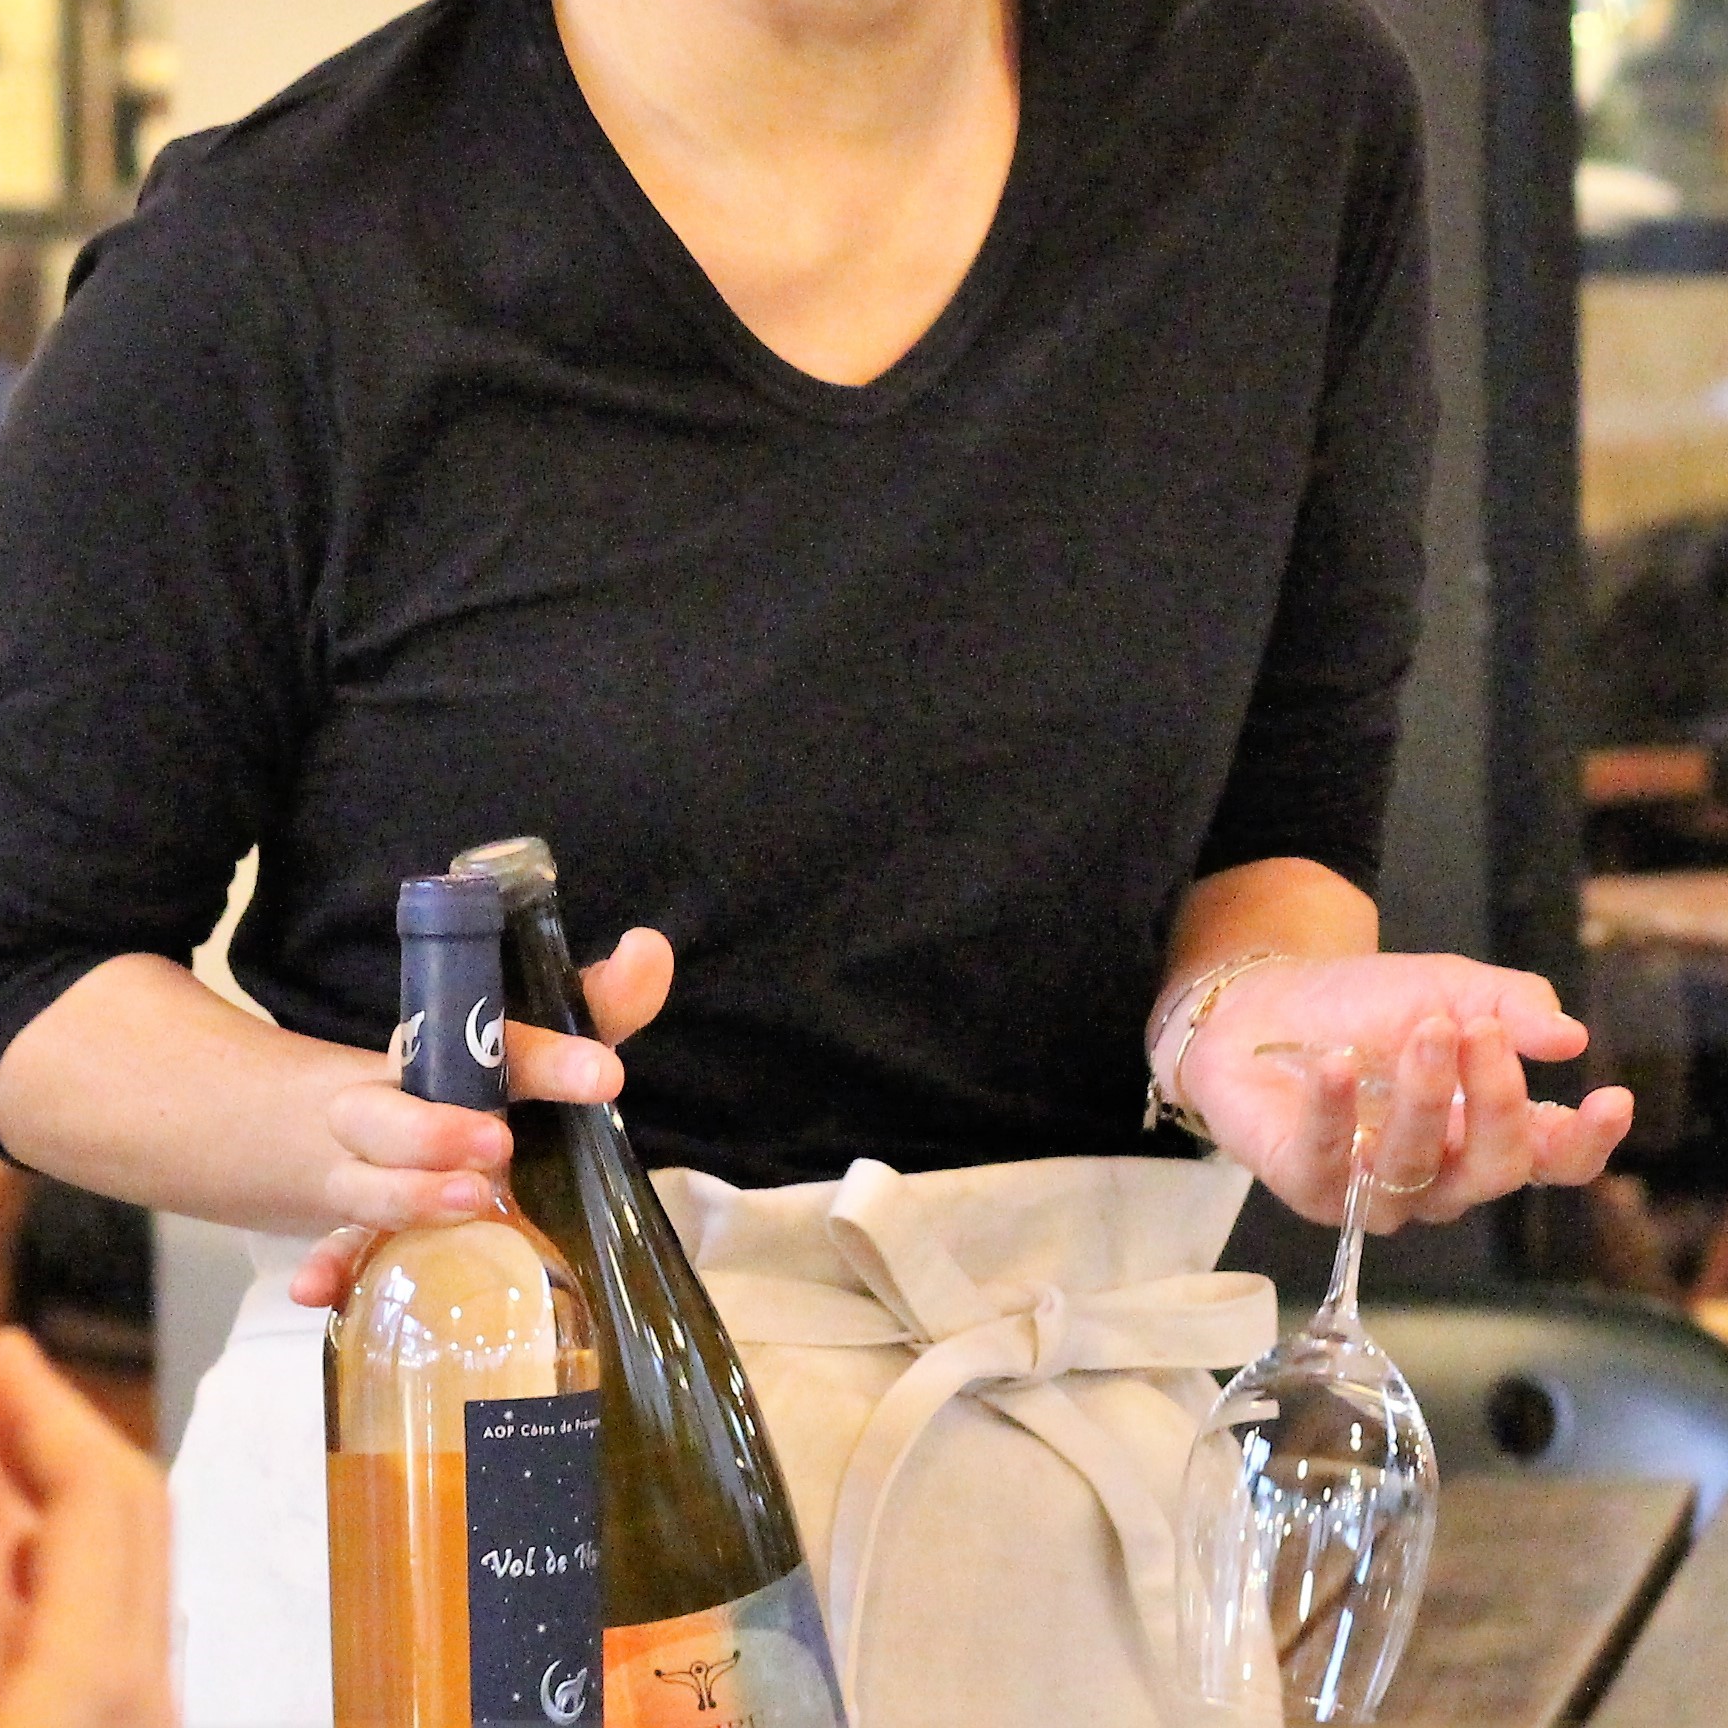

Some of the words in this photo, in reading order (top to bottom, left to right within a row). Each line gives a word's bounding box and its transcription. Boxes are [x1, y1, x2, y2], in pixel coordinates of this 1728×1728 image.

[482, 1424, 515, 1440] AOP
[559, 1418, 573, 1434] de
[480, 1546, 536, 1579] Vol
[545, 1545, 569, 1575] de
